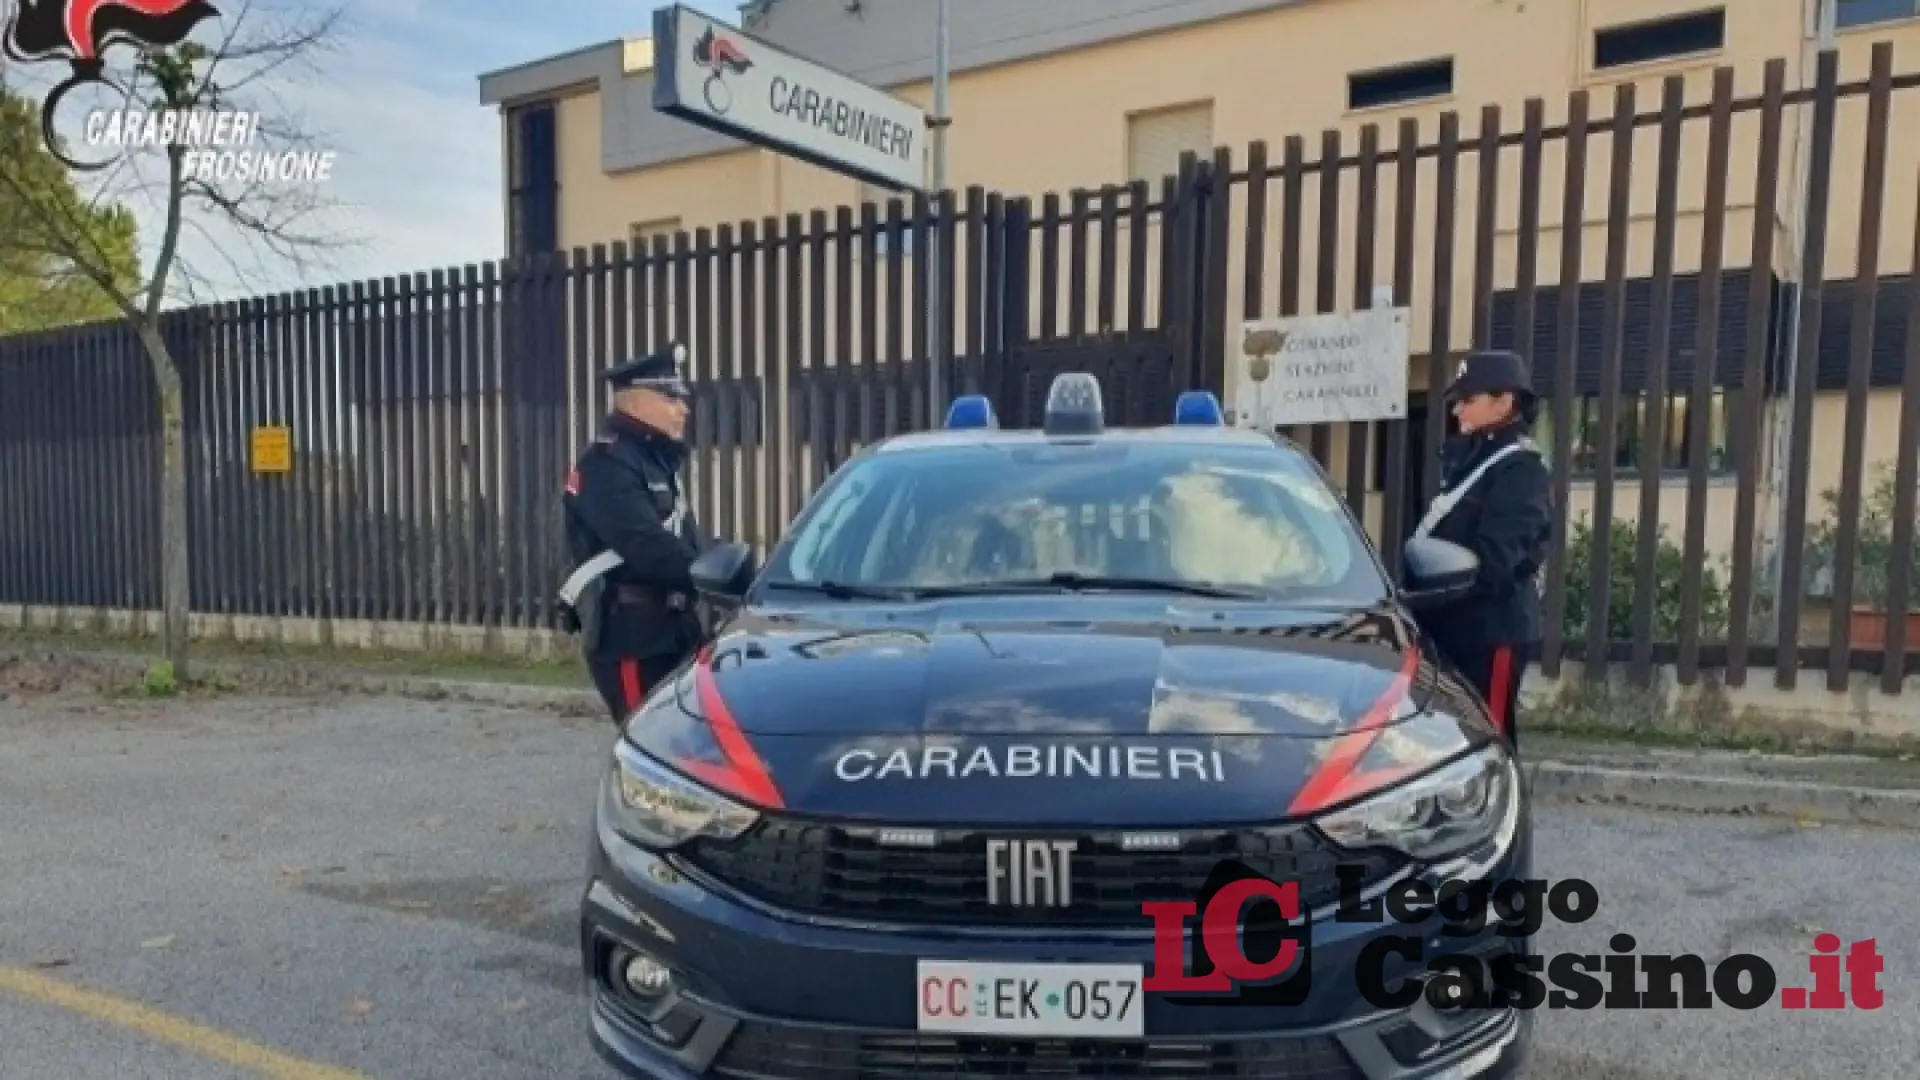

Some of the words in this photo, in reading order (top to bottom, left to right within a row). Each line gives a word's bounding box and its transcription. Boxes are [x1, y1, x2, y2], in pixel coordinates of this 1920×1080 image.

[769, 75, 913, 160] CARABINIERI
[835, 745, 1225, 782] CARABINIERI
[986, 839, 1078, 907] FIAT
[922, 976, 968, 1016] CC
